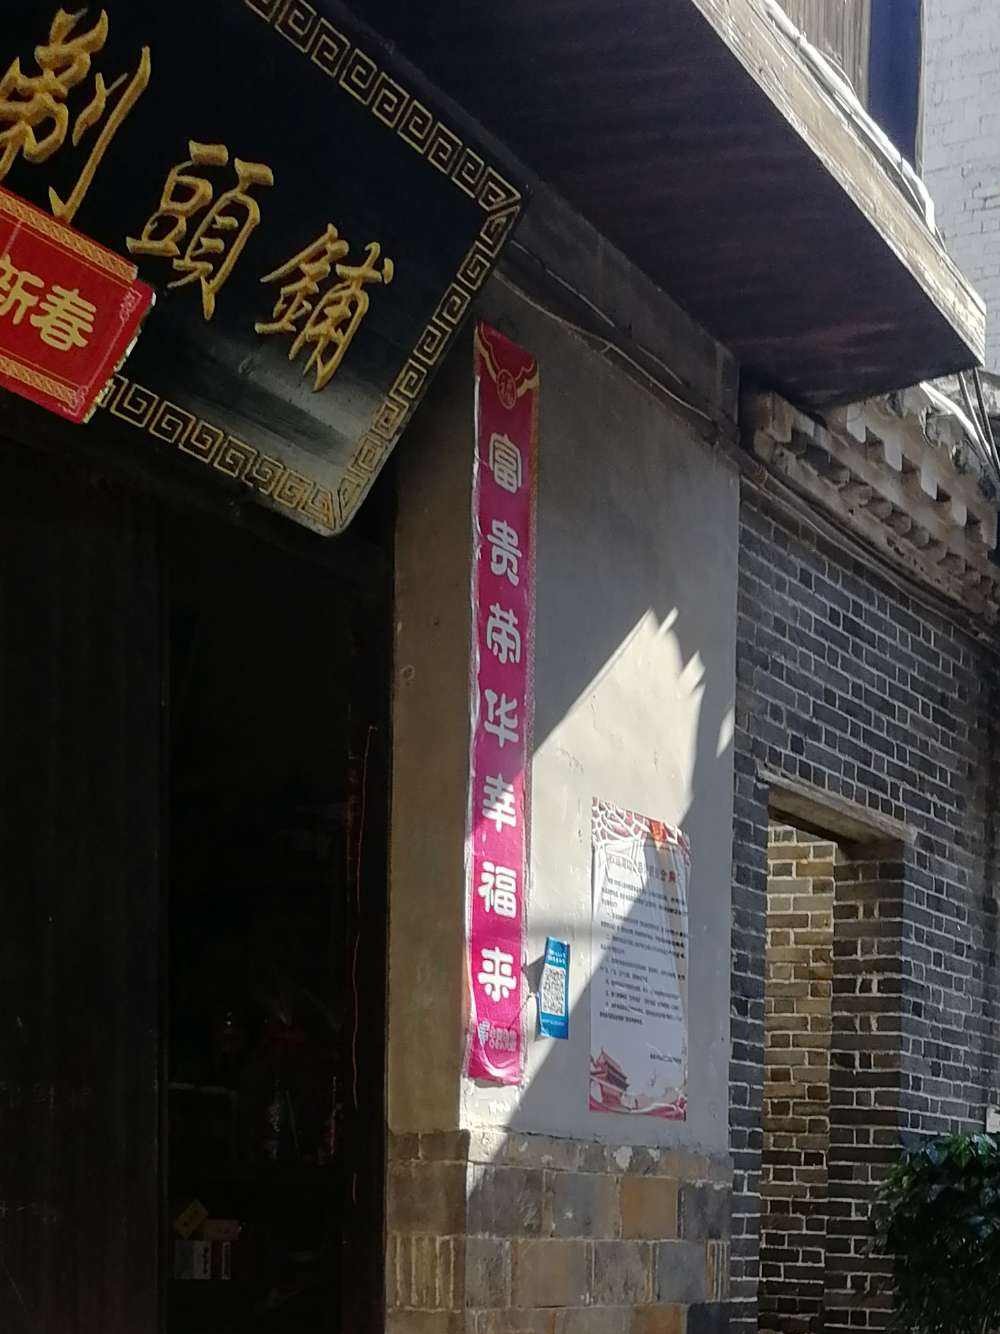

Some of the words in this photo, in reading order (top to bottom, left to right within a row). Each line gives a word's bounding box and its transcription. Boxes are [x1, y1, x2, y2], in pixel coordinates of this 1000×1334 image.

[476, 432, 523, 1003] 富贵荣华幸福来
